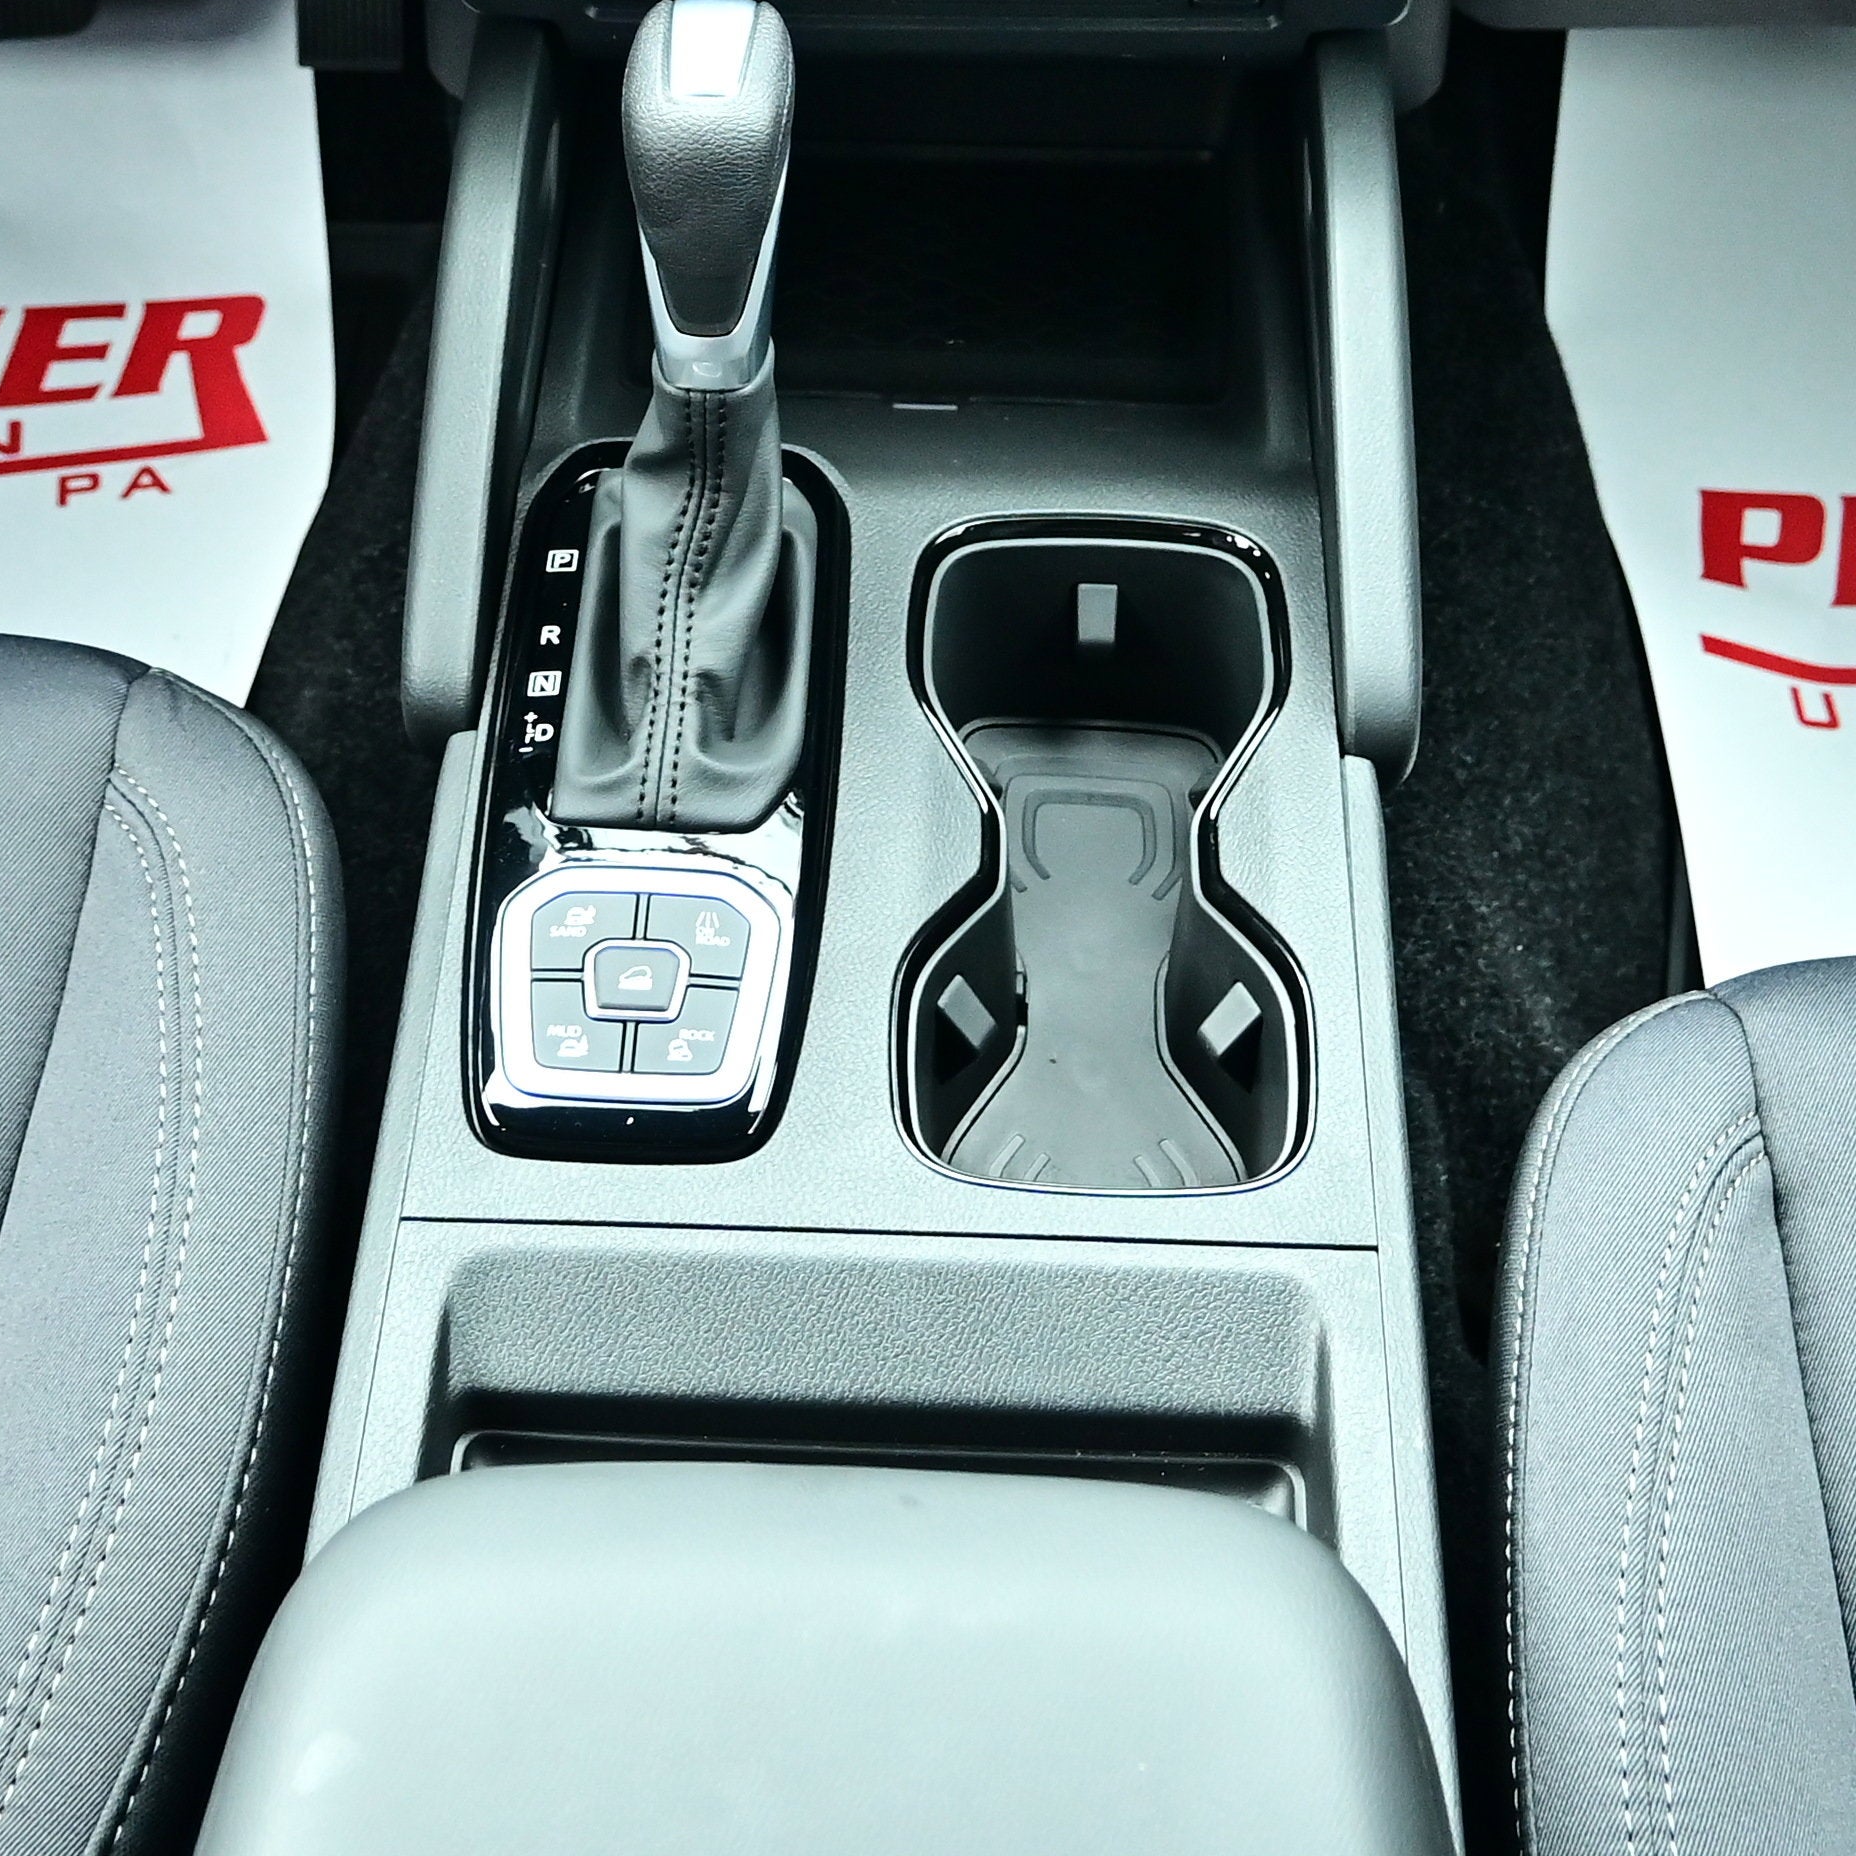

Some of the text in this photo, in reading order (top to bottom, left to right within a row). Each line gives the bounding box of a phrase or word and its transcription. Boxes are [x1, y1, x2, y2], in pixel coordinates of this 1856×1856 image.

[56, 464, 174, 510] PA
[540, 625, 562, 645] R
[534, 723, 555, 743] D
